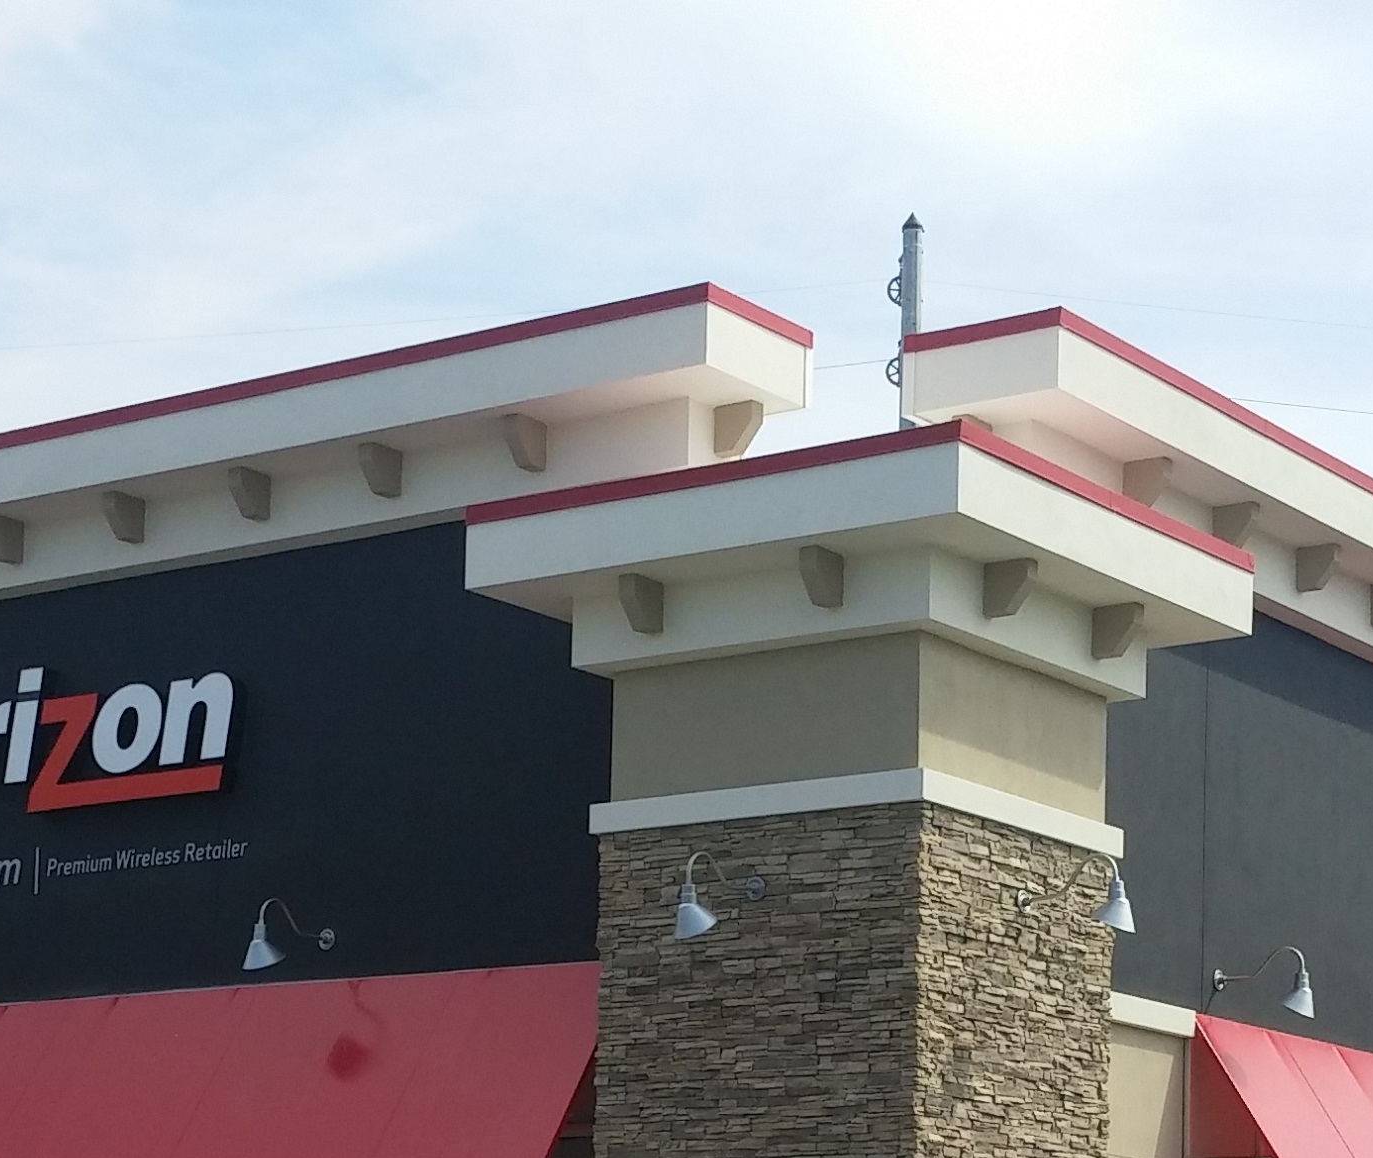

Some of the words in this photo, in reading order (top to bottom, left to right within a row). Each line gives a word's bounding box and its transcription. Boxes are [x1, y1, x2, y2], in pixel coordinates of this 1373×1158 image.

[46, 855, 113, 877] Premium
[116, 845, 181, 870] Wireless
[185, 839, 248, 862] Retailer
